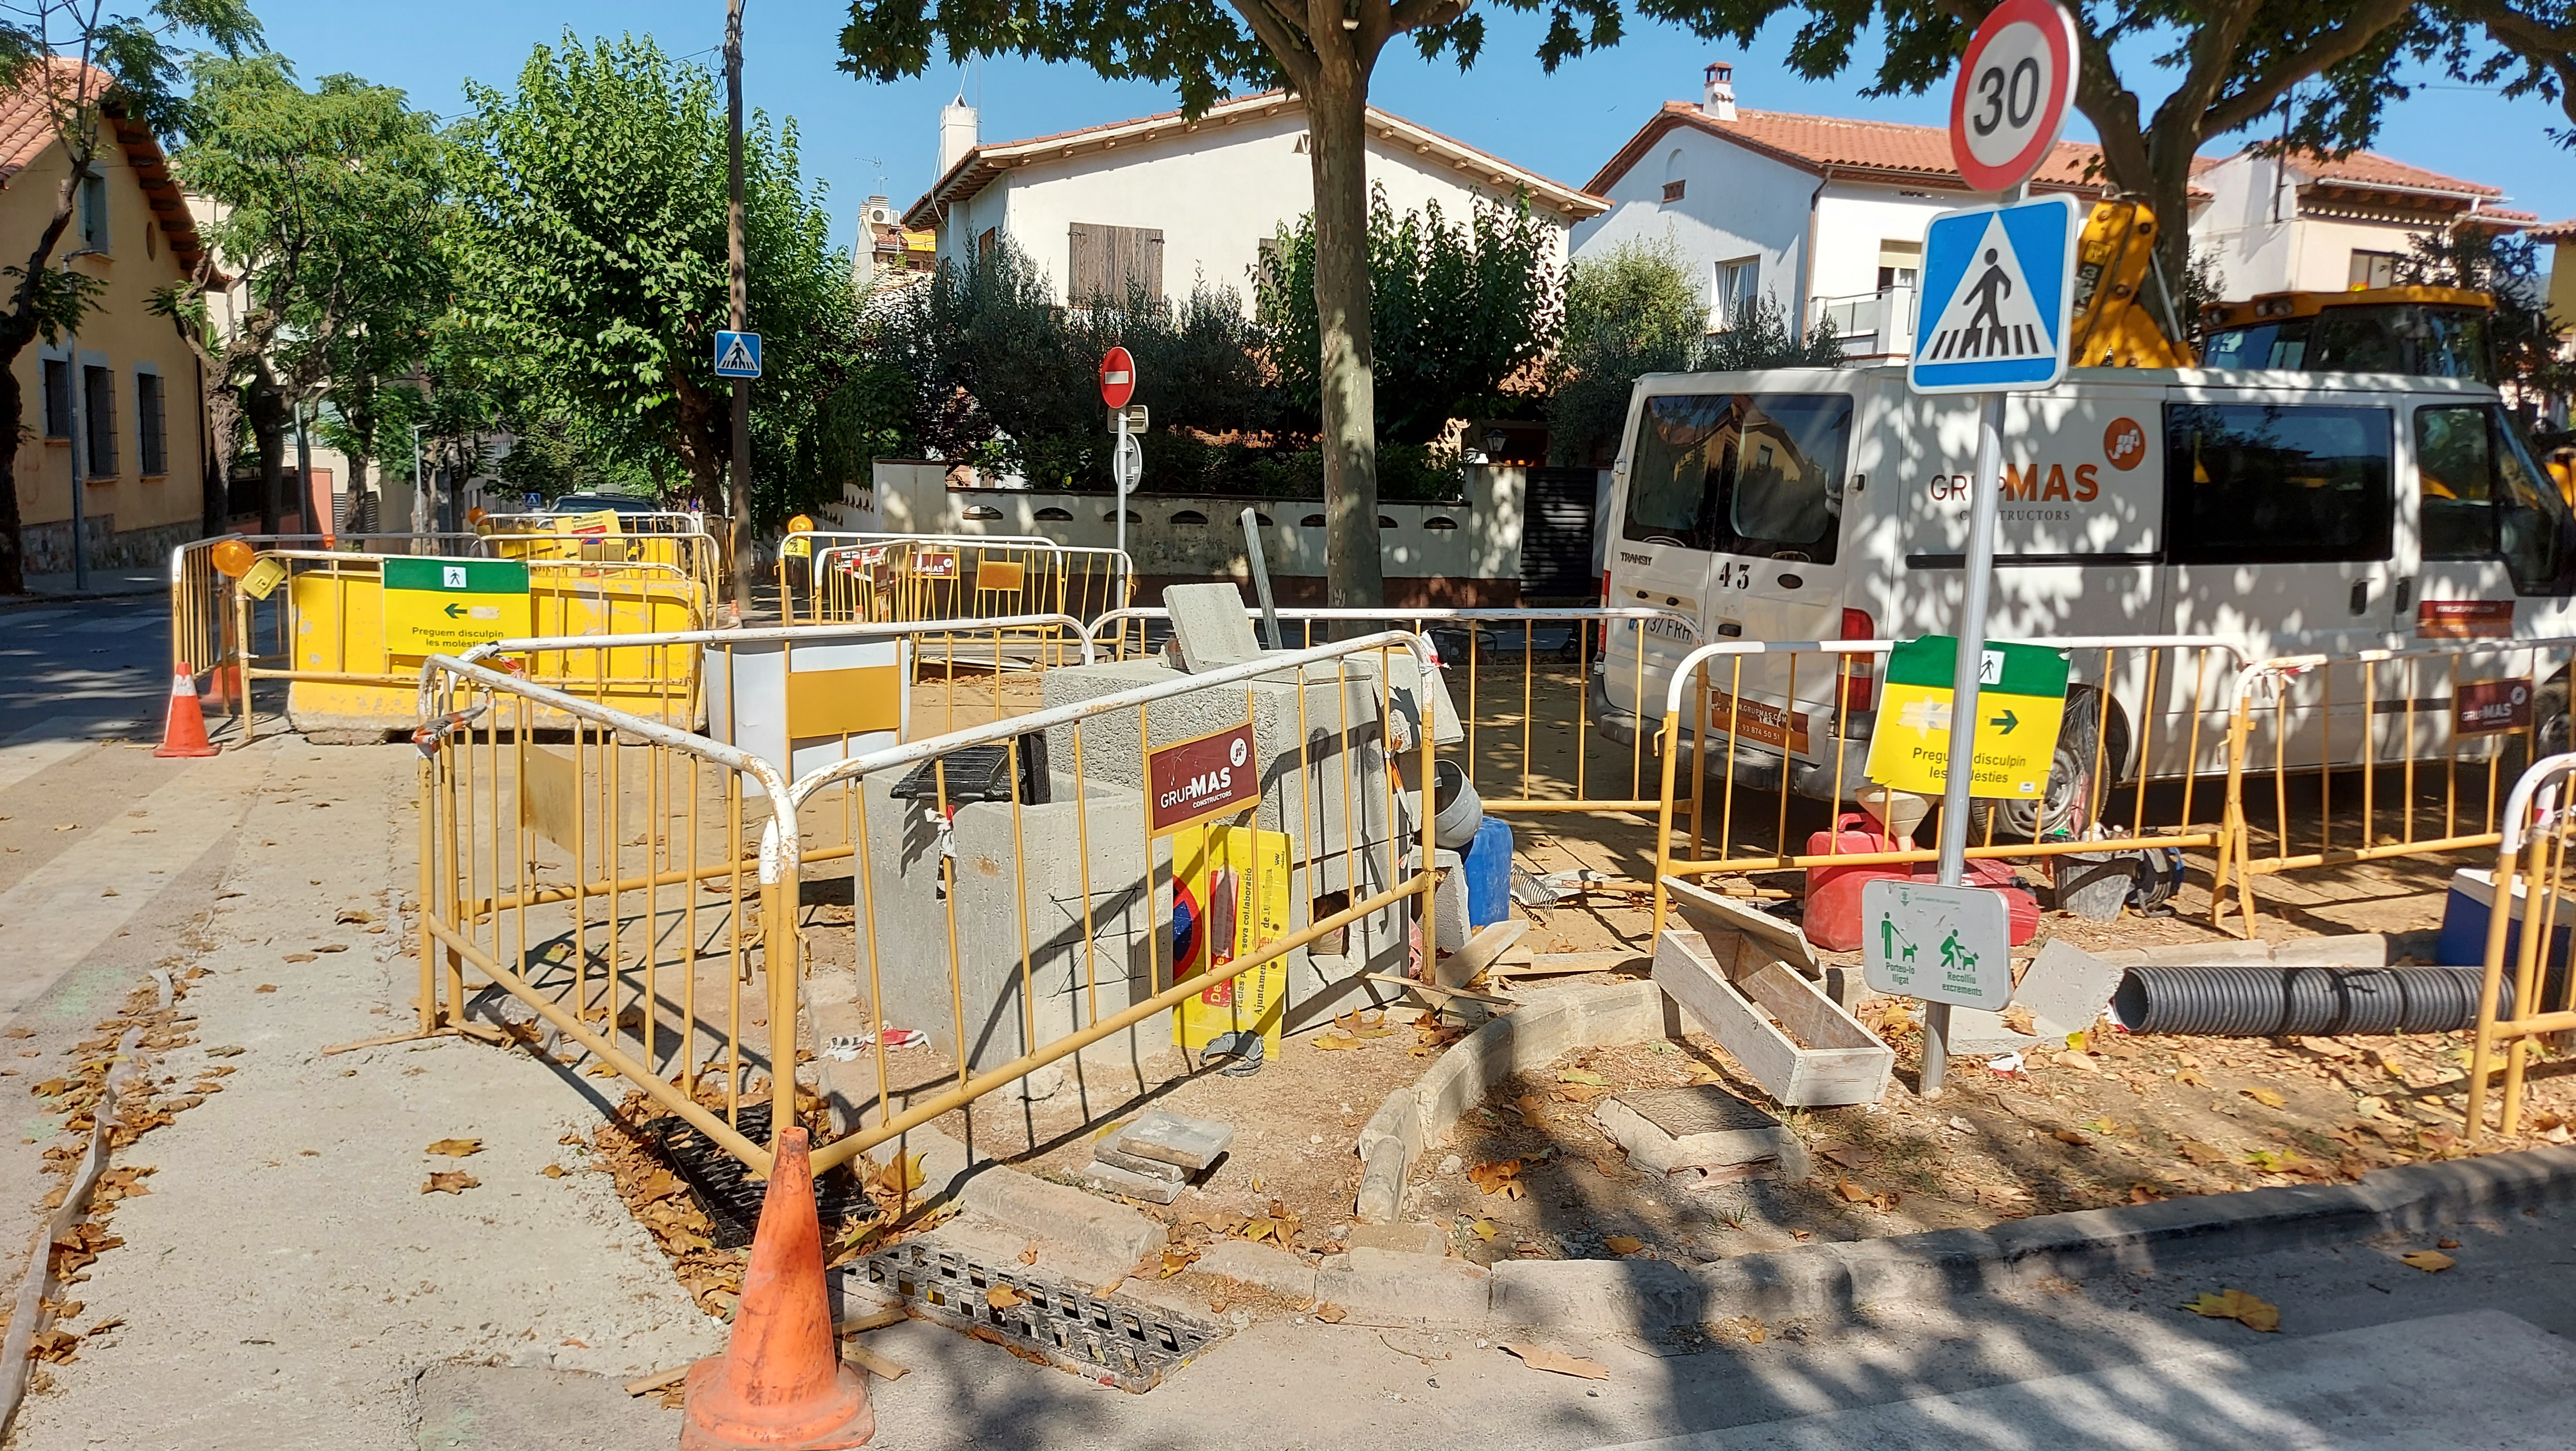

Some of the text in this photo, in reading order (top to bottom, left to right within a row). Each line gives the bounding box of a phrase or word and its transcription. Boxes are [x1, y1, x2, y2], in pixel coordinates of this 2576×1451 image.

[1973, 57, 2039, 137] 30
[412, 627, 504, 639] Preguem disculpin
[426, 639, 483, 648] les molèsti
[1742, 724, 1750, 732] 93
[1751, 727, 1762, 736] 874
[1764, 730, 1772, 739] 50
[1773, 732, 1780, 741] 51
[1913, 747, 2027, 769] Pregu disculpin
[1929, 766, 2009, 783] les lèsties
[1160, 767, 1231, 808] GRUPMAS
[1192, 790, 1233, 808] CONSTRUCTORS
[1242, 867, 1252, 926] col.laboració
[1253, 963, 1266, 1016] Ajuntamen
[1261, 917, 1270, 929] de
[1886, 962, 1915, 975] Porteu-lo
[1892, 973, 1909, 986] lligat
[1946, 971, 1977, 984] Recolliu
[1941, 983, 1983, 997] excrements
